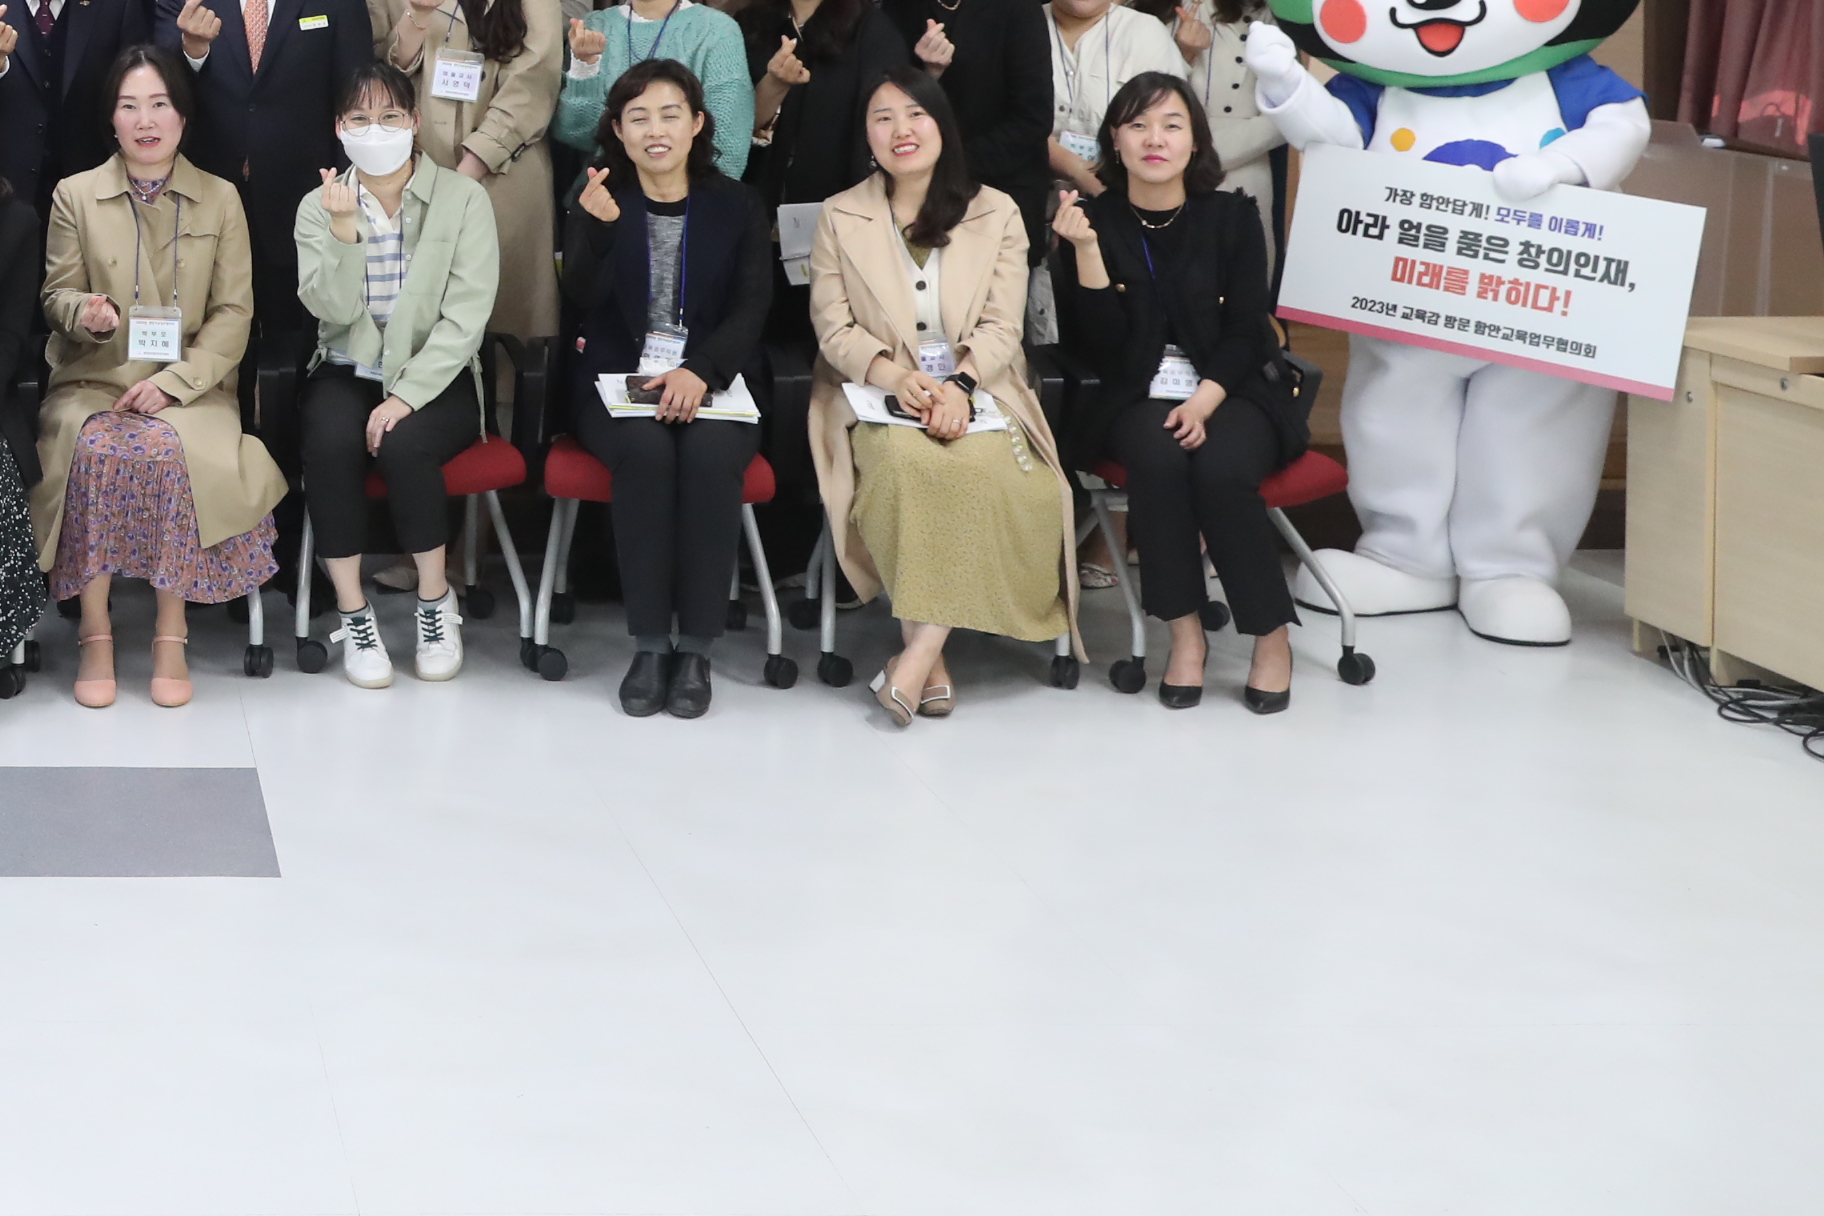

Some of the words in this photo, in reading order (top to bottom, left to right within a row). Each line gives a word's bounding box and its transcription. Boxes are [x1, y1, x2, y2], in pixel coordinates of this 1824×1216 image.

[1384, 186, 1416, 206] 가장
[1419, 192, 1491, 220] 함안답게!
[1494, 206, 1544, 230] 모두를
[1548, 215, 1604, 241] 이롭게!
[1336, 207, 1390, 241] 아라
[1397, 218, 1449, 253] 얼을
[1455, 229, 1510, 264] 품은
[1517, 240, 1636, 293] 창의인재,
[1390, 255, 1470, 296] 미래를
[1476, 272, 1573, 317] 밝히다!
[1350, 295, 1398, 318] 2023년
[1400, 305, 1441, 326] 교육감
[1444, 314, 1471, 333] 방문
[1474, 320, 1598, 359] 함안교육업무협의회
